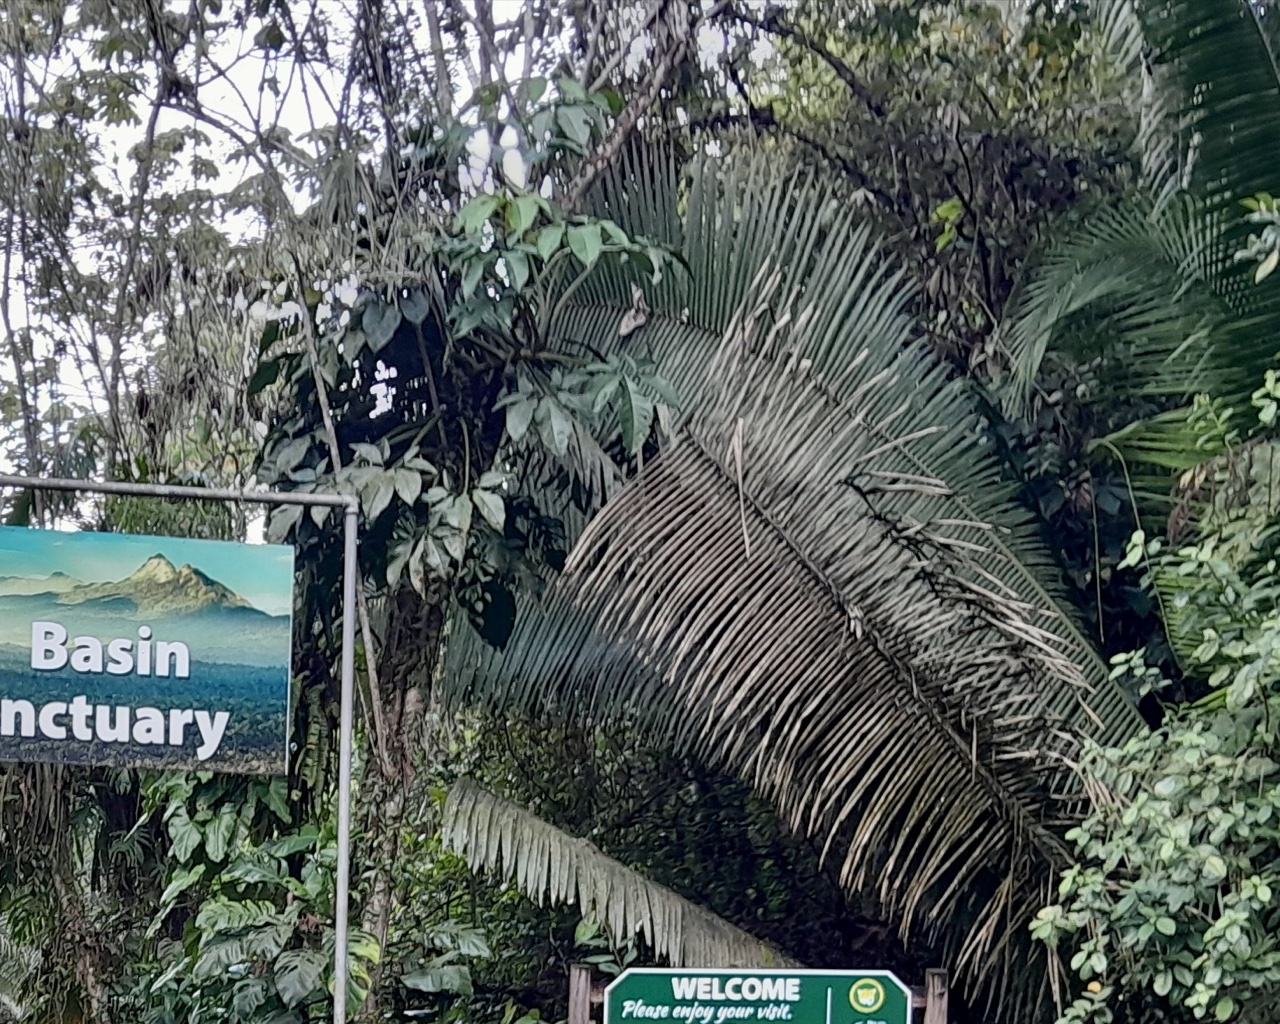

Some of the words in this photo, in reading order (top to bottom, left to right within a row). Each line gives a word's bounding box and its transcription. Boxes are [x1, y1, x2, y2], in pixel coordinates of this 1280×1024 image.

[31, 621, 190, 679] Basin
[671, 977, 800, 1001] WELCOME
[621, 999, 669, 1019] Please
[672, 1001, 715, 1024] enjoy
[713, 1004, 755, 1024] your
[757, 1003, 792, 1020] visit.
